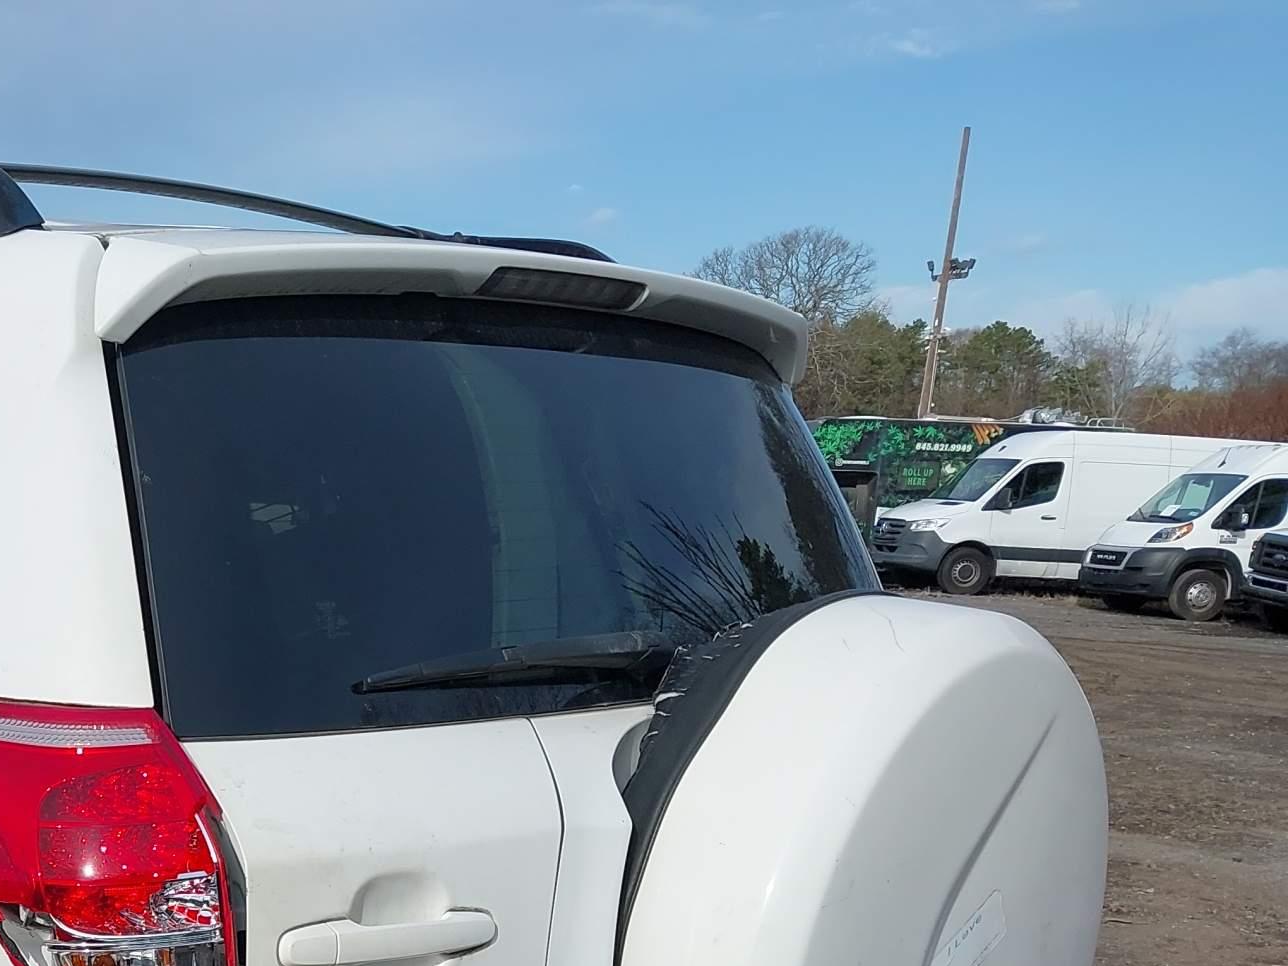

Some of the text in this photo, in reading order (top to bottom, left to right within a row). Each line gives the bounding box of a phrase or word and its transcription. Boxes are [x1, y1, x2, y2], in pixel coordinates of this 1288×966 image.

[903, 467, 934, 477] ROLL UP
[907, 477, 927, 486] HERE
